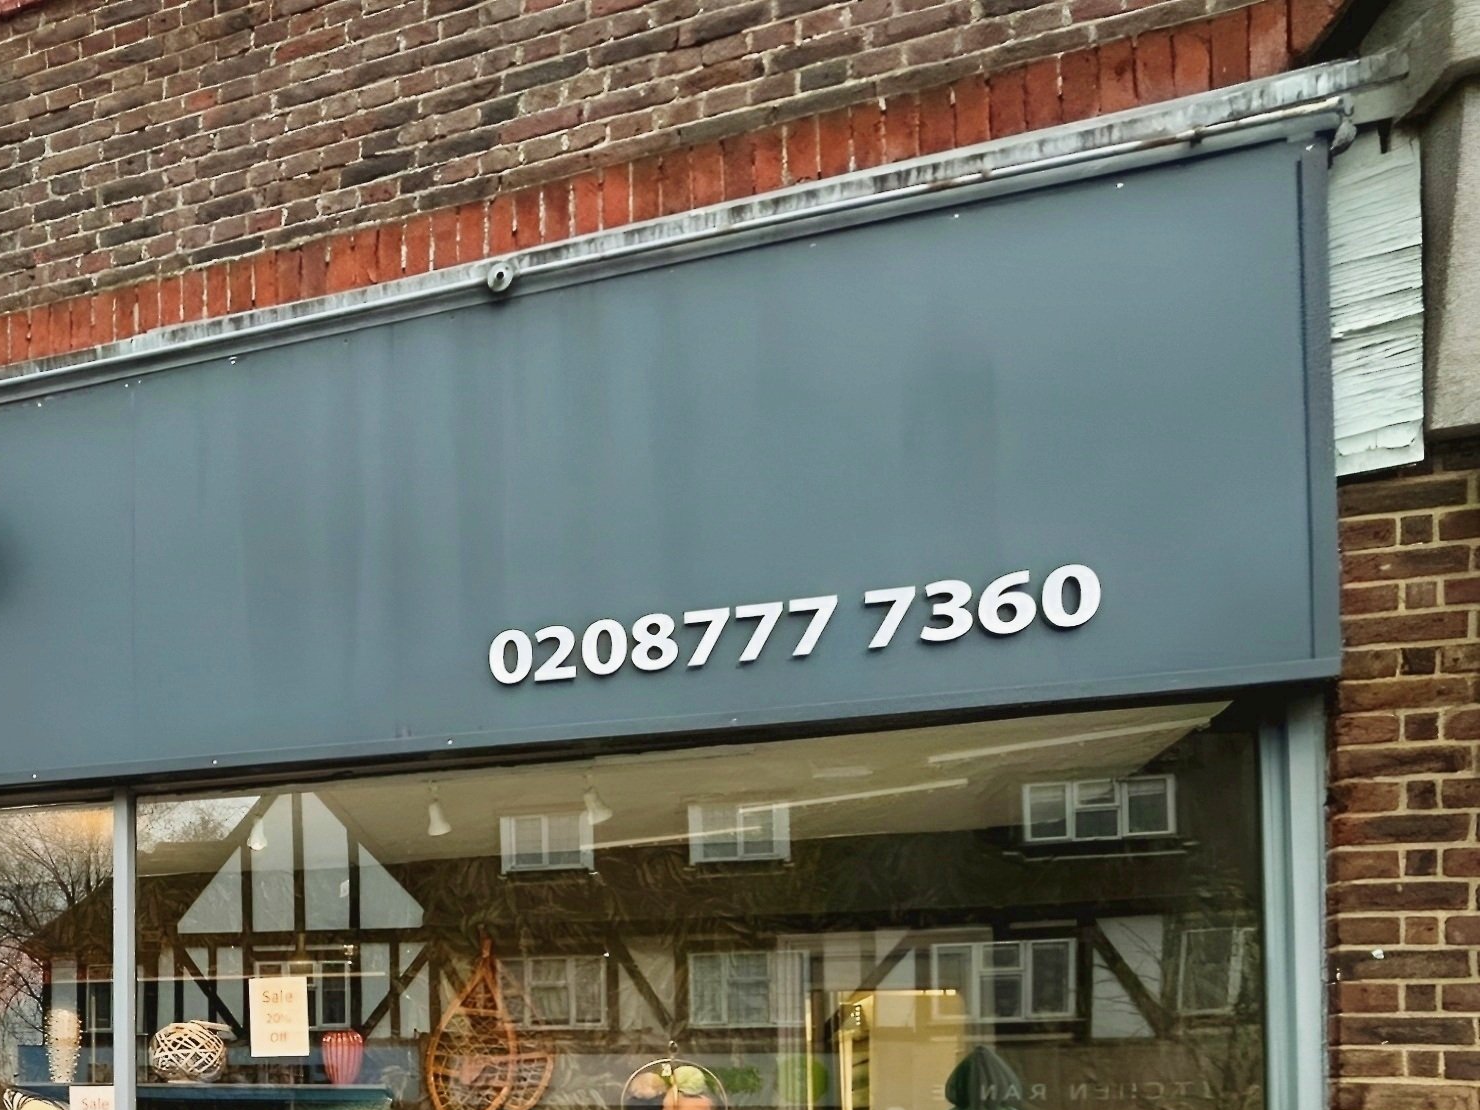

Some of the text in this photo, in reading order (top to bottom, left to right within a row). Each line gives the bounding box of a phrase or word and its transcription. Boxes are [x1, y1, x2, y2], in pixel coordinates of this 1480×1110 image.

[488, 563, 1102, 684] 0208777 7360
[262, 990, 293, 1004] Sale
